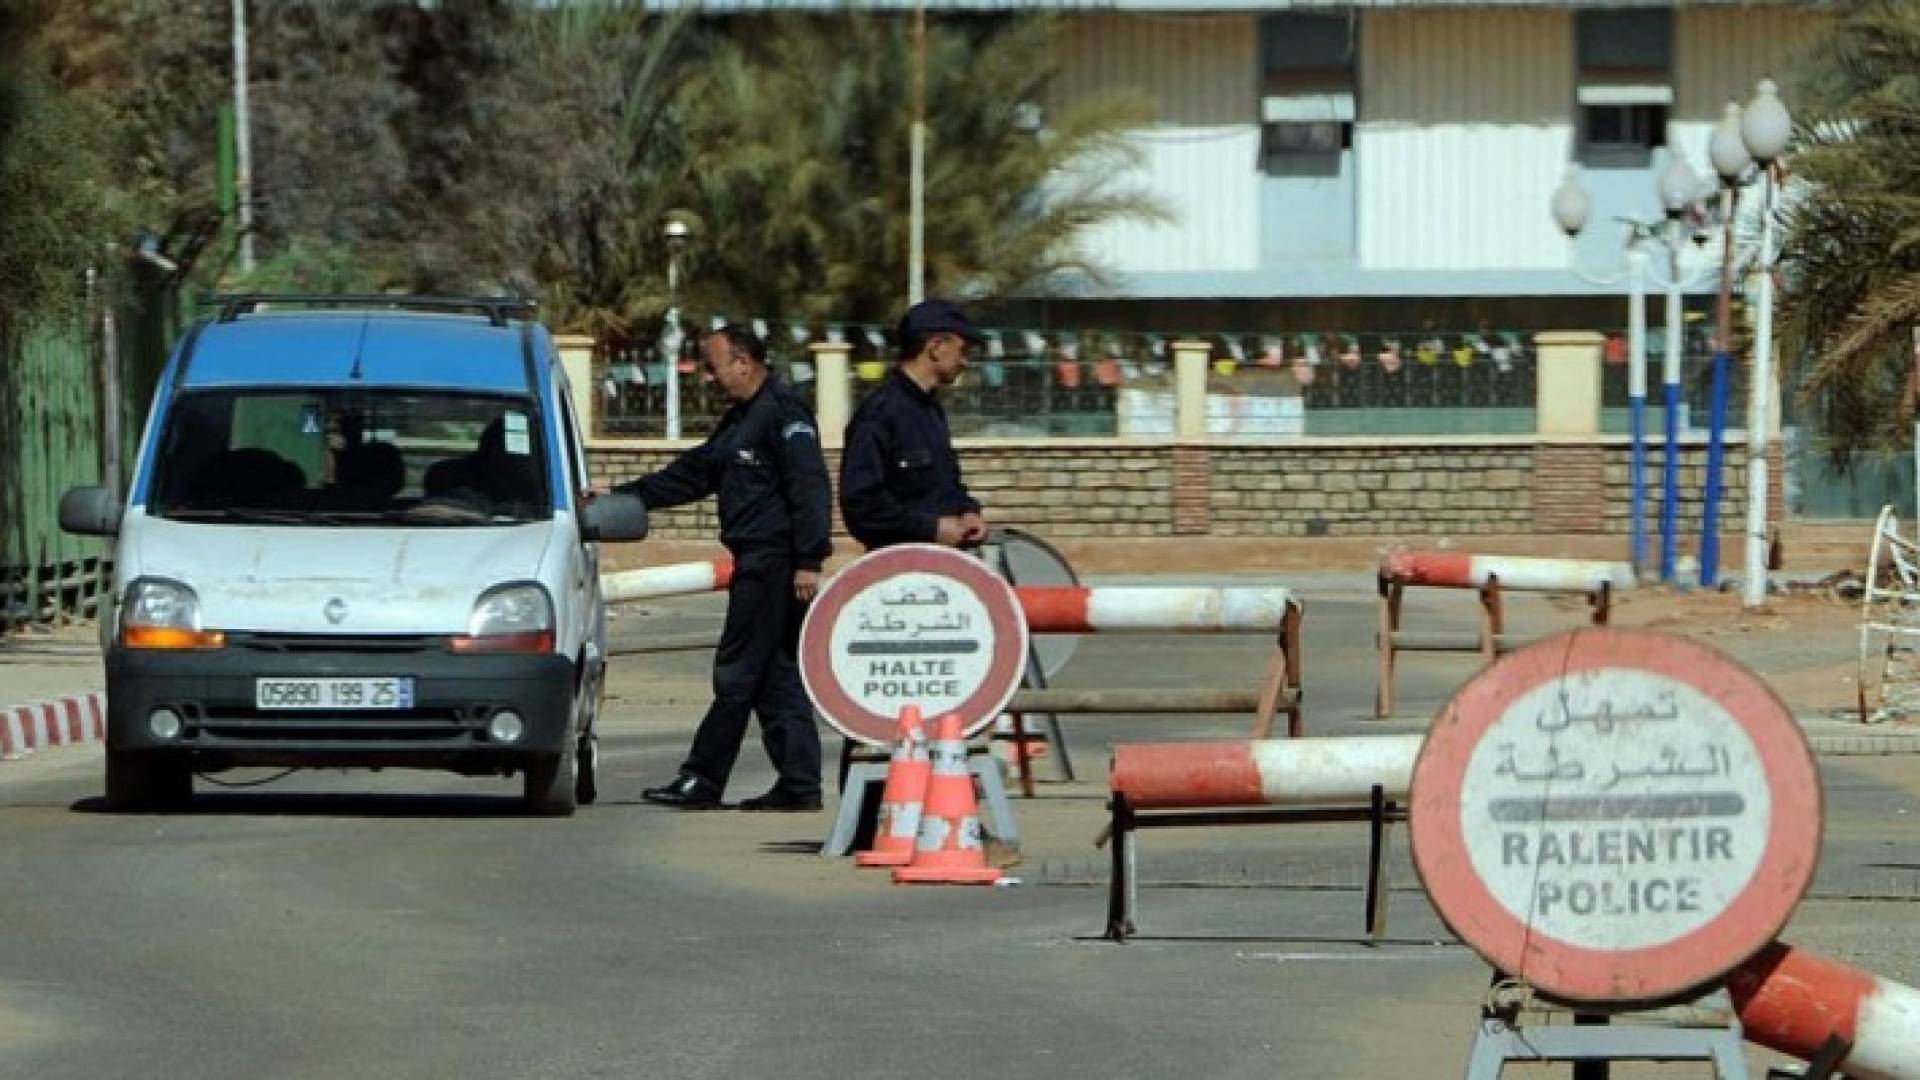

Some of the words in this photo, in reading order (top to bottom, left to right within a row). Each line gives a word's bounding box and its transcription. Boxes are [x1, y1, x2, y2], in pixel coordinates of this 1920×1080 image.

[858, 612, 970, 637] الشرطة
[869, 660, 955, 676] HALTE
[331, 682, 364, 706] 199
[371, 681, 396, 706] 25
[863, 680, 961, 697] POLICE
[1536, 690, 1679, 734] تمهل
[1495, 742, 1732, 789] الشرطة
[1502, 826, 1734, 866] RALENTIR
[1537, 877, 1702, 916] POLICE
